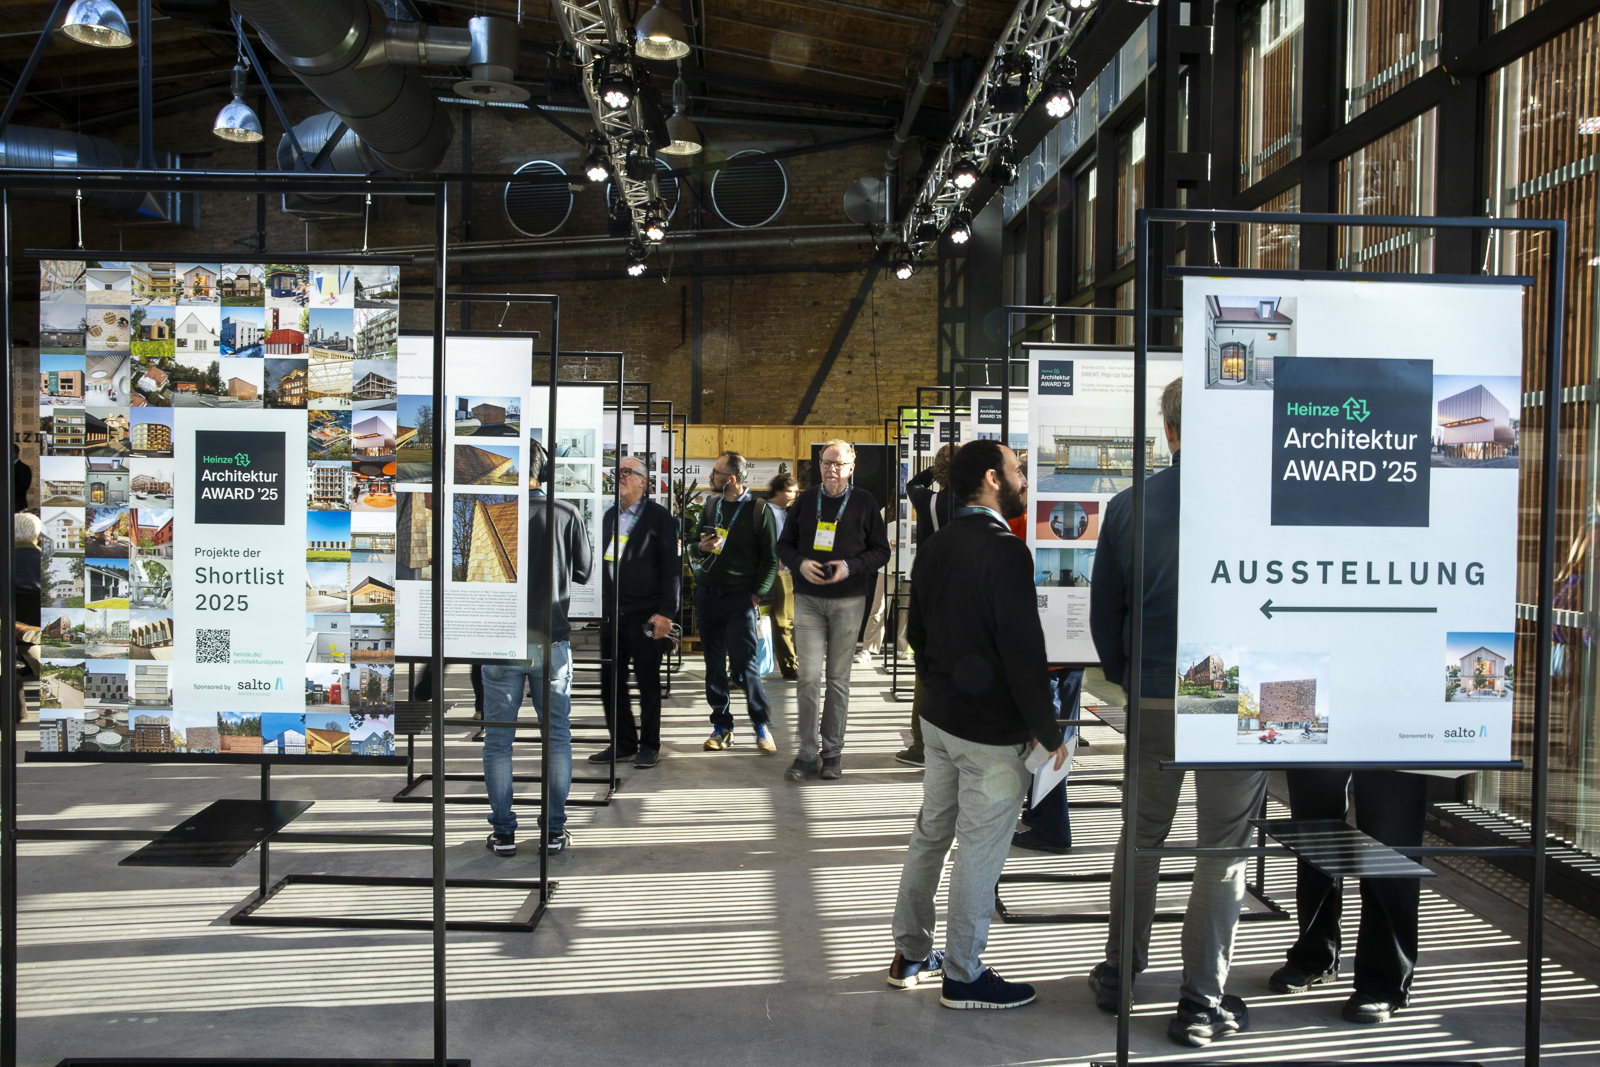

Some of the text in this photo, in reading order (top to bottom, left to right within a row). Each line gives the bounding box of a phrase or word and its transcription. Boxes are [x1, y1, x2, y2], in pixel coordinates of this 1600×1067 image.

[1286, 402, 1340, 417] Heinze
[14, 432, 40, 443] IZI
[1283, 427, 1418, 451] Architektur
[203, 455, 233, 464] Heinze
[201, 469, 278, 482] Architektur
[1282, 459, 1418, 483] AWARD '25
[201, 487, 279, 500] AWARD '25
[194, 547, 261, 559] Projekte der
[195, 566, 285, 585] Shortlist
[1210, 560, 1485, 586] AUSSTELLUNG
[195, 593, 249, 612] 2025
[232, 658, 284, 666] architekturobjekte
[193, 683, 223, 691] Sponsored
[237, 678, 271, 691] salto
[1443, 726, 1476, 738] salto
